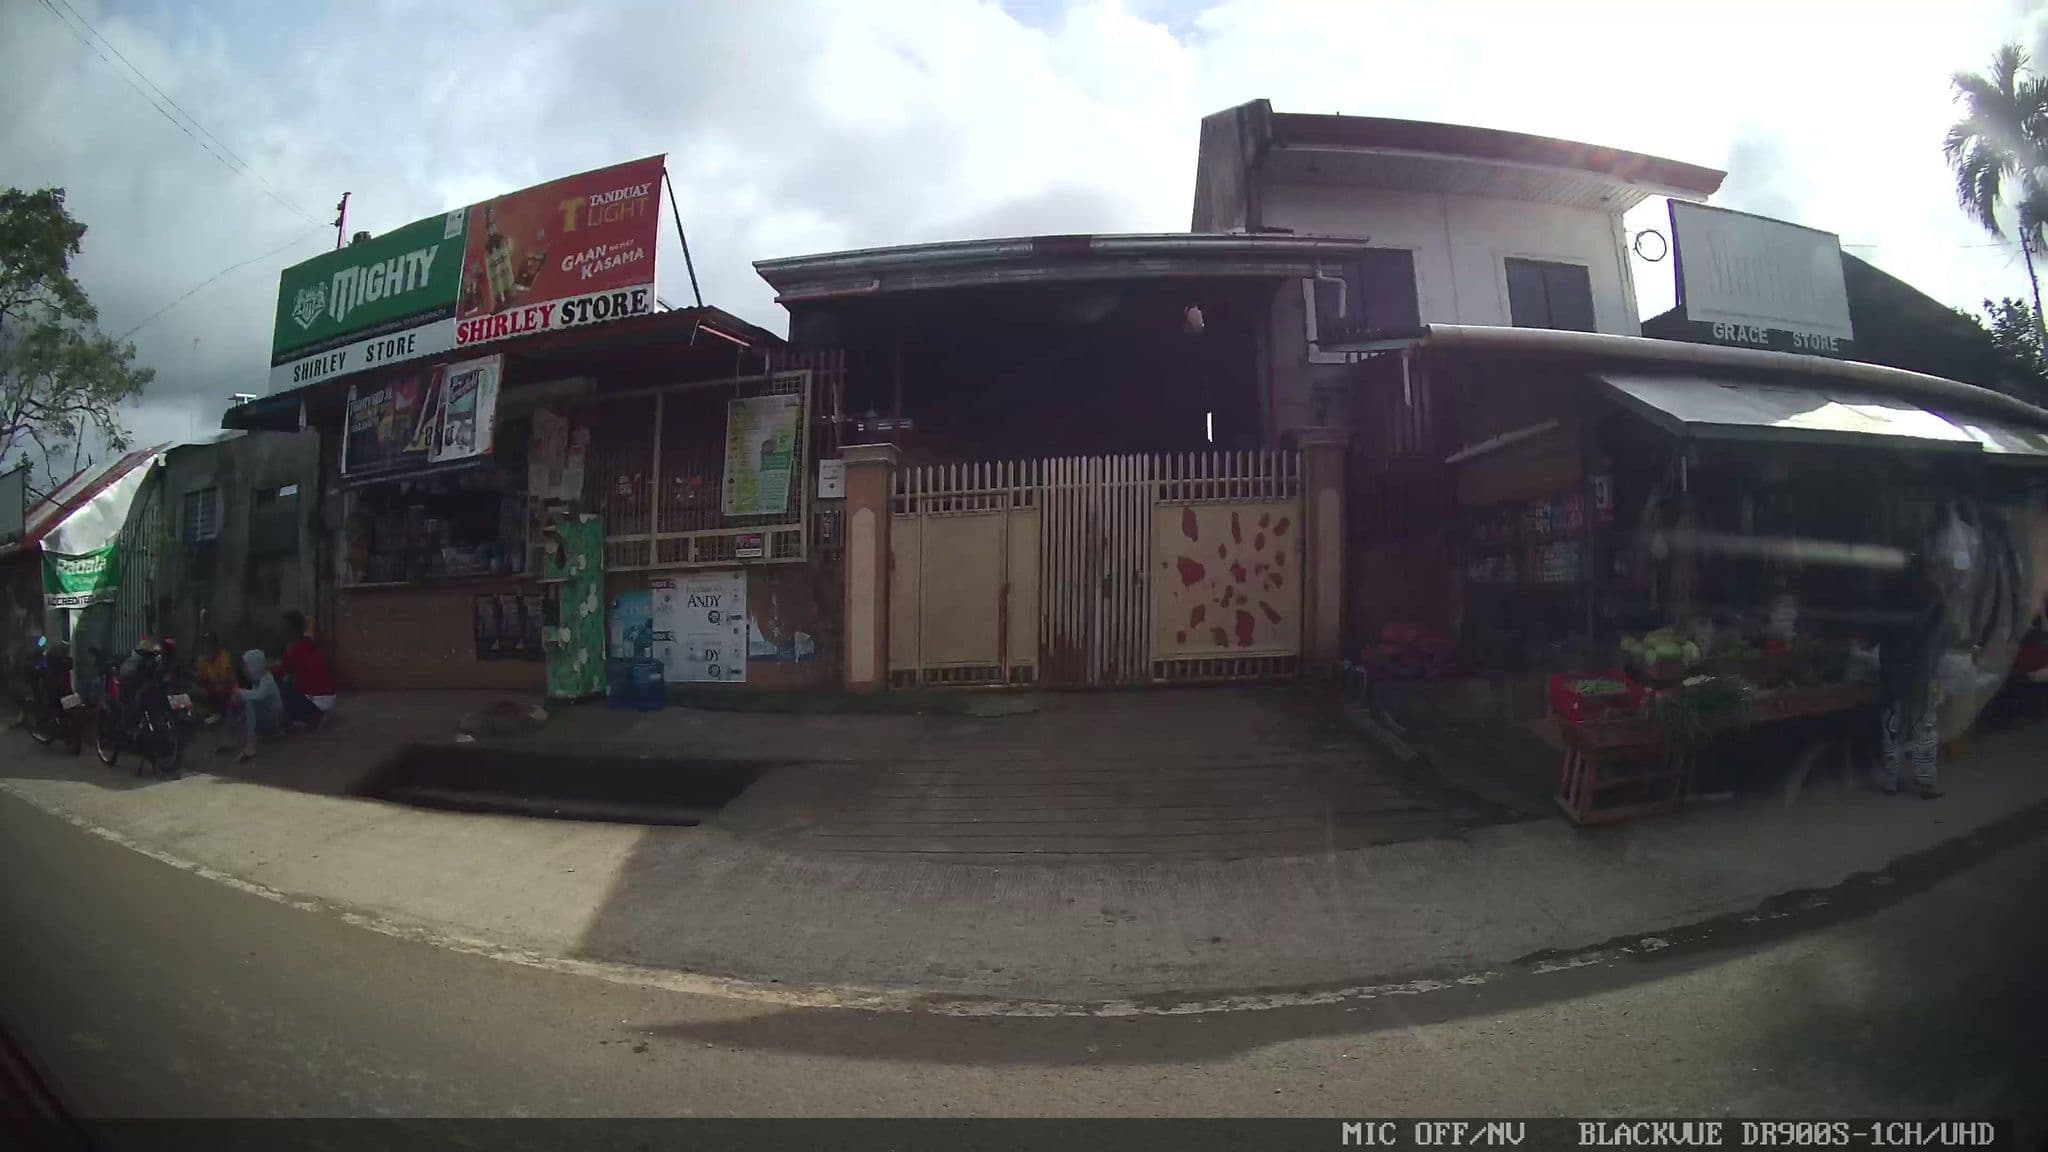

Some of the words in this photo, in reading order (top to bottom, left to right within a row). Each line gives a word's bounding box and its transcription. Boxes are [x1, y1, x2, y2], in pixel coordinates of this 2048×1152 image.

[589, 182, 652, 207] TANDUAY
[587, 197, 649, 228] LIGHT
[561, 244, 607, 272] GAAN
[581, 248, 645, 280] KASAMA
[328, 244, 440, 323] MIGHTY
[456, 303, 556, 345] SHIRLEY
[560, 288, 648, 324] STORE
[1712, 321, 1769, 345] GRACE
[1792, 332, 1840, 353] STORE
[293, 351, 346, 383] SHIRLEY
[365, 333, 416, 363] STORE
[687, 594, 722, 608] ANDY
